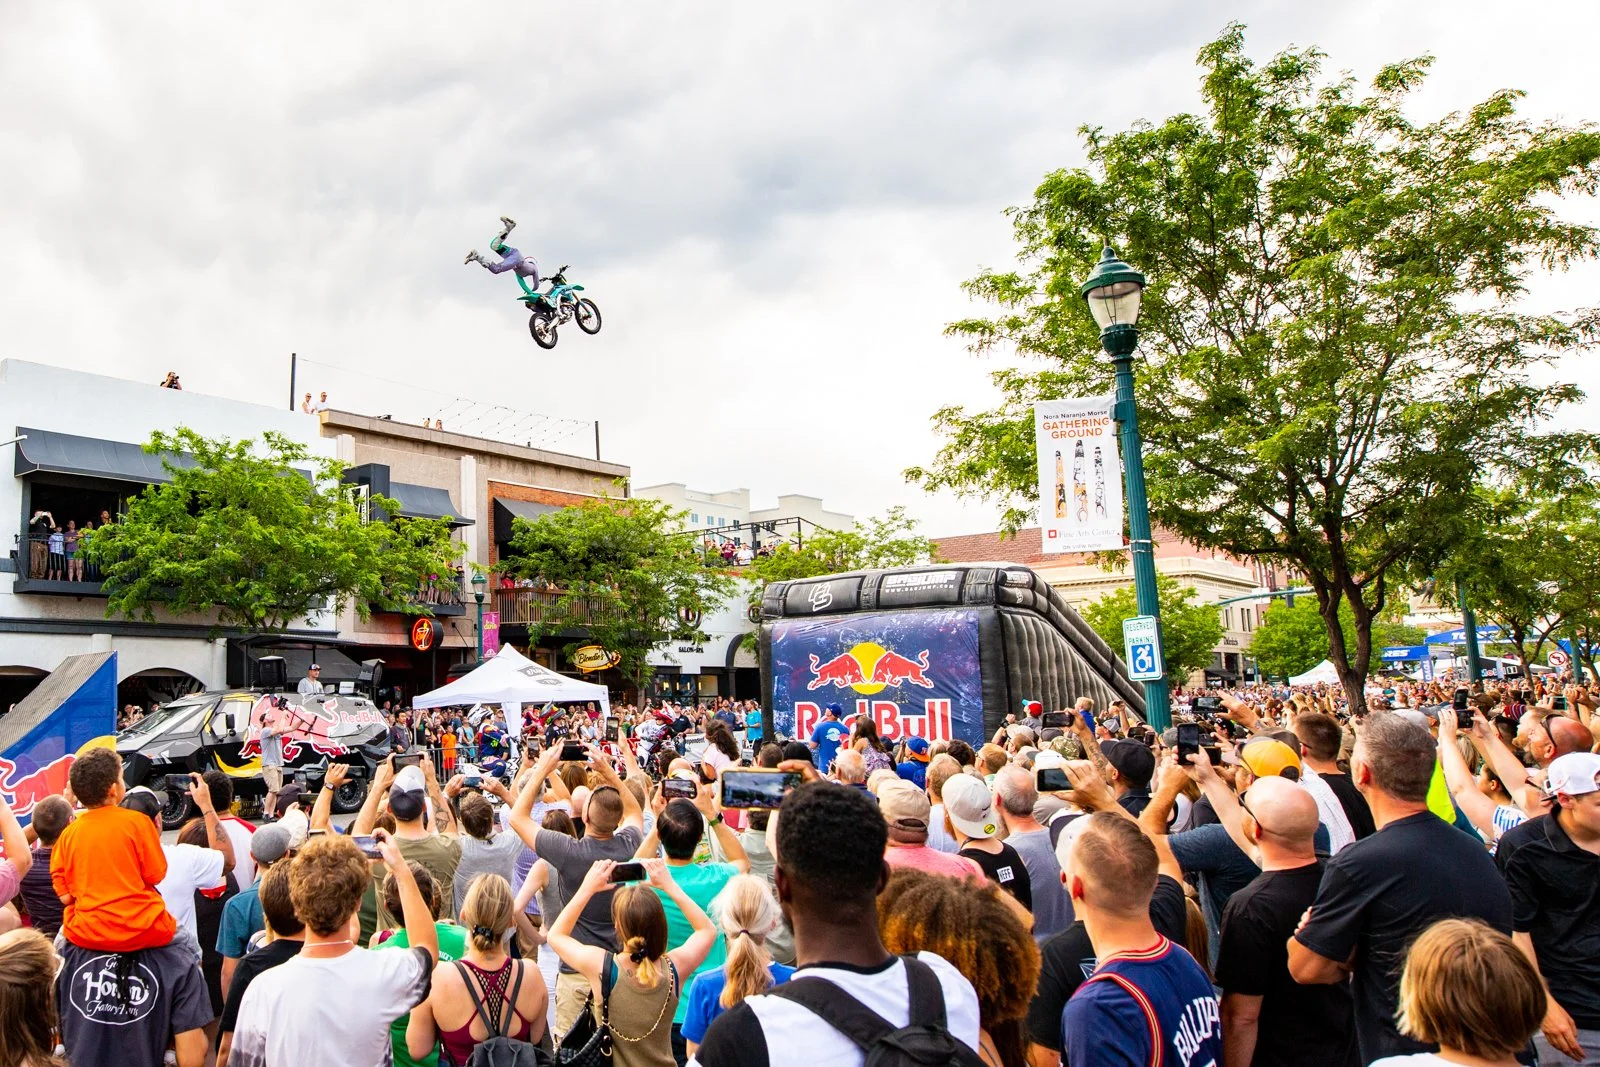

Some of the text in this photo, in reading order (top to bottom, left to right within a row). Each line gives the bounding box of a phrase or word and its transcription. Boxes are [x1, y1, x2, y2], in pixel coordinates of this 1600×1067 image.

[1043, 417, 1110, 431] GATHERING
[1051, 428, 1103, 440] GROUND
[1059, 528, 1116, 538] Fine Arts Center
[1125, 621, 1154, 631] RESERVED
[1128, 635, 1154, 645] PARKING
[1173, 996, 1221, 1067] BILLUP
